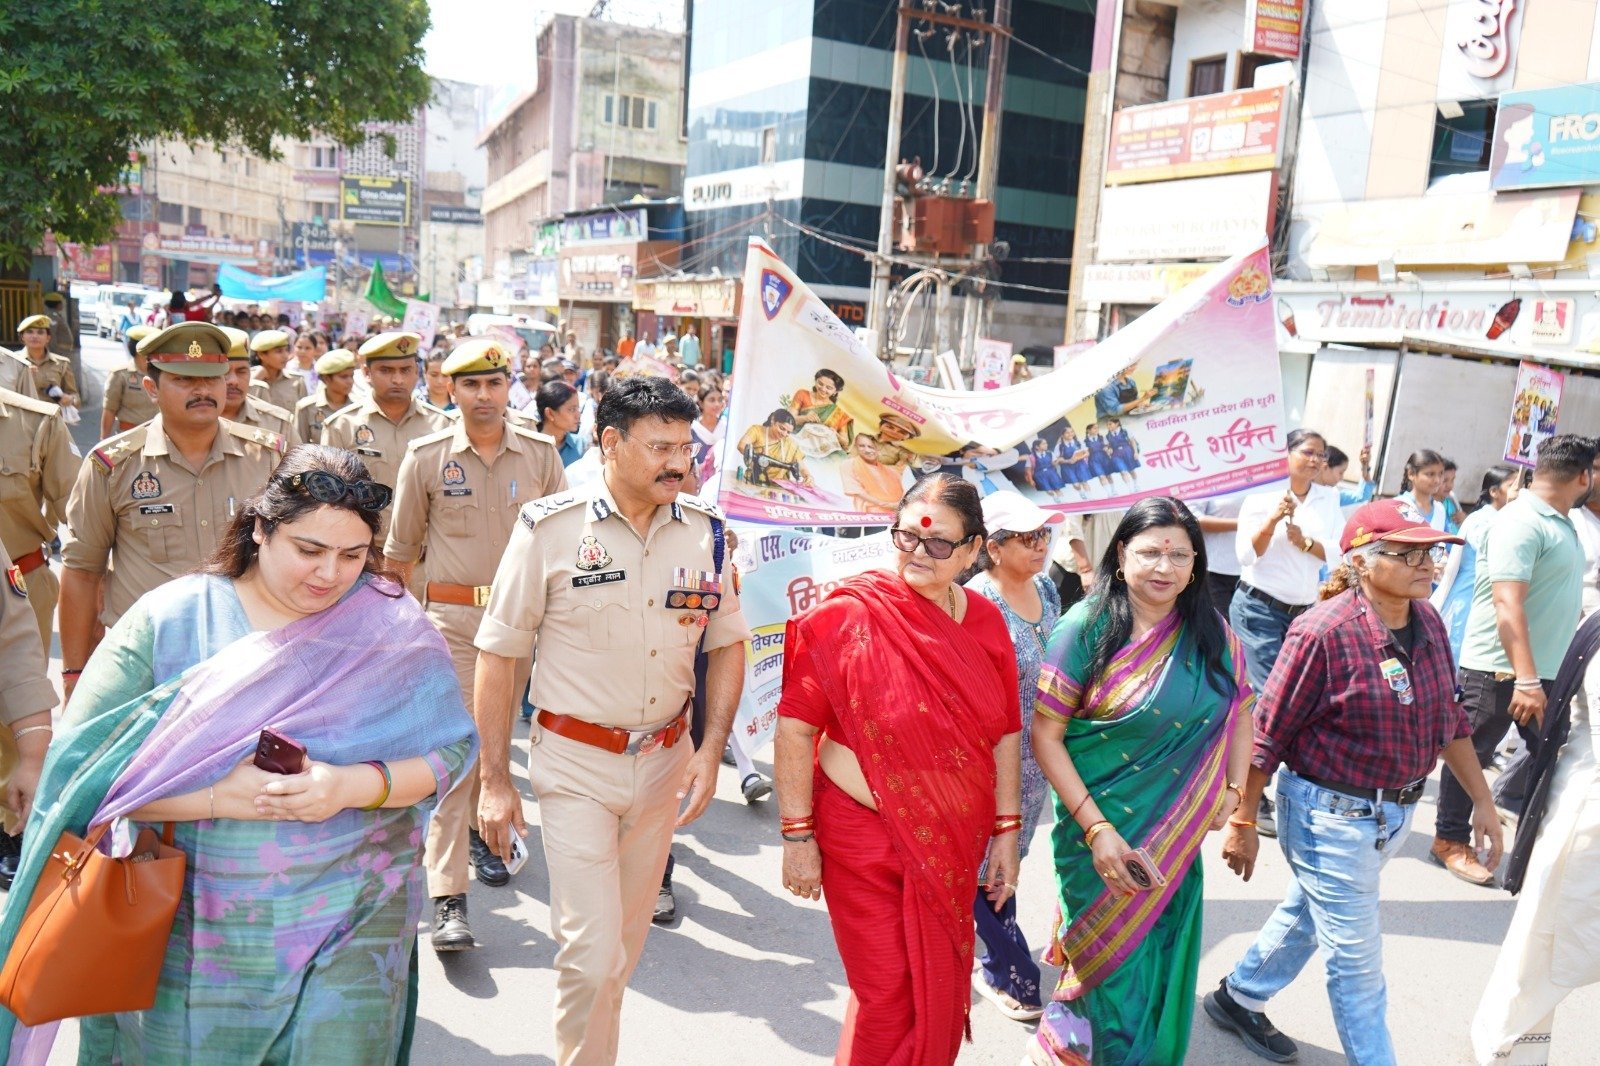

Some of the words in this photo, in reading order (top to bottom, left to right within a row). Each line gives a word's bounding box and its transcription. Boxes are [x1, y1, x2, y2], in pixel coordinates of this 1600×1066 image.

[1146, 414, 1188, 430] विकसित
[1190, 409, 1210, 421] उत्तर
[1212, 403, 1237, 415] प्रदेश
[1239, 397, 1254, 409] की
[1143, 431, 1200, 472] नारी
[1206, 417, 1288, 463] शक्ति
[754, 653, 784, 677] सम्मा
